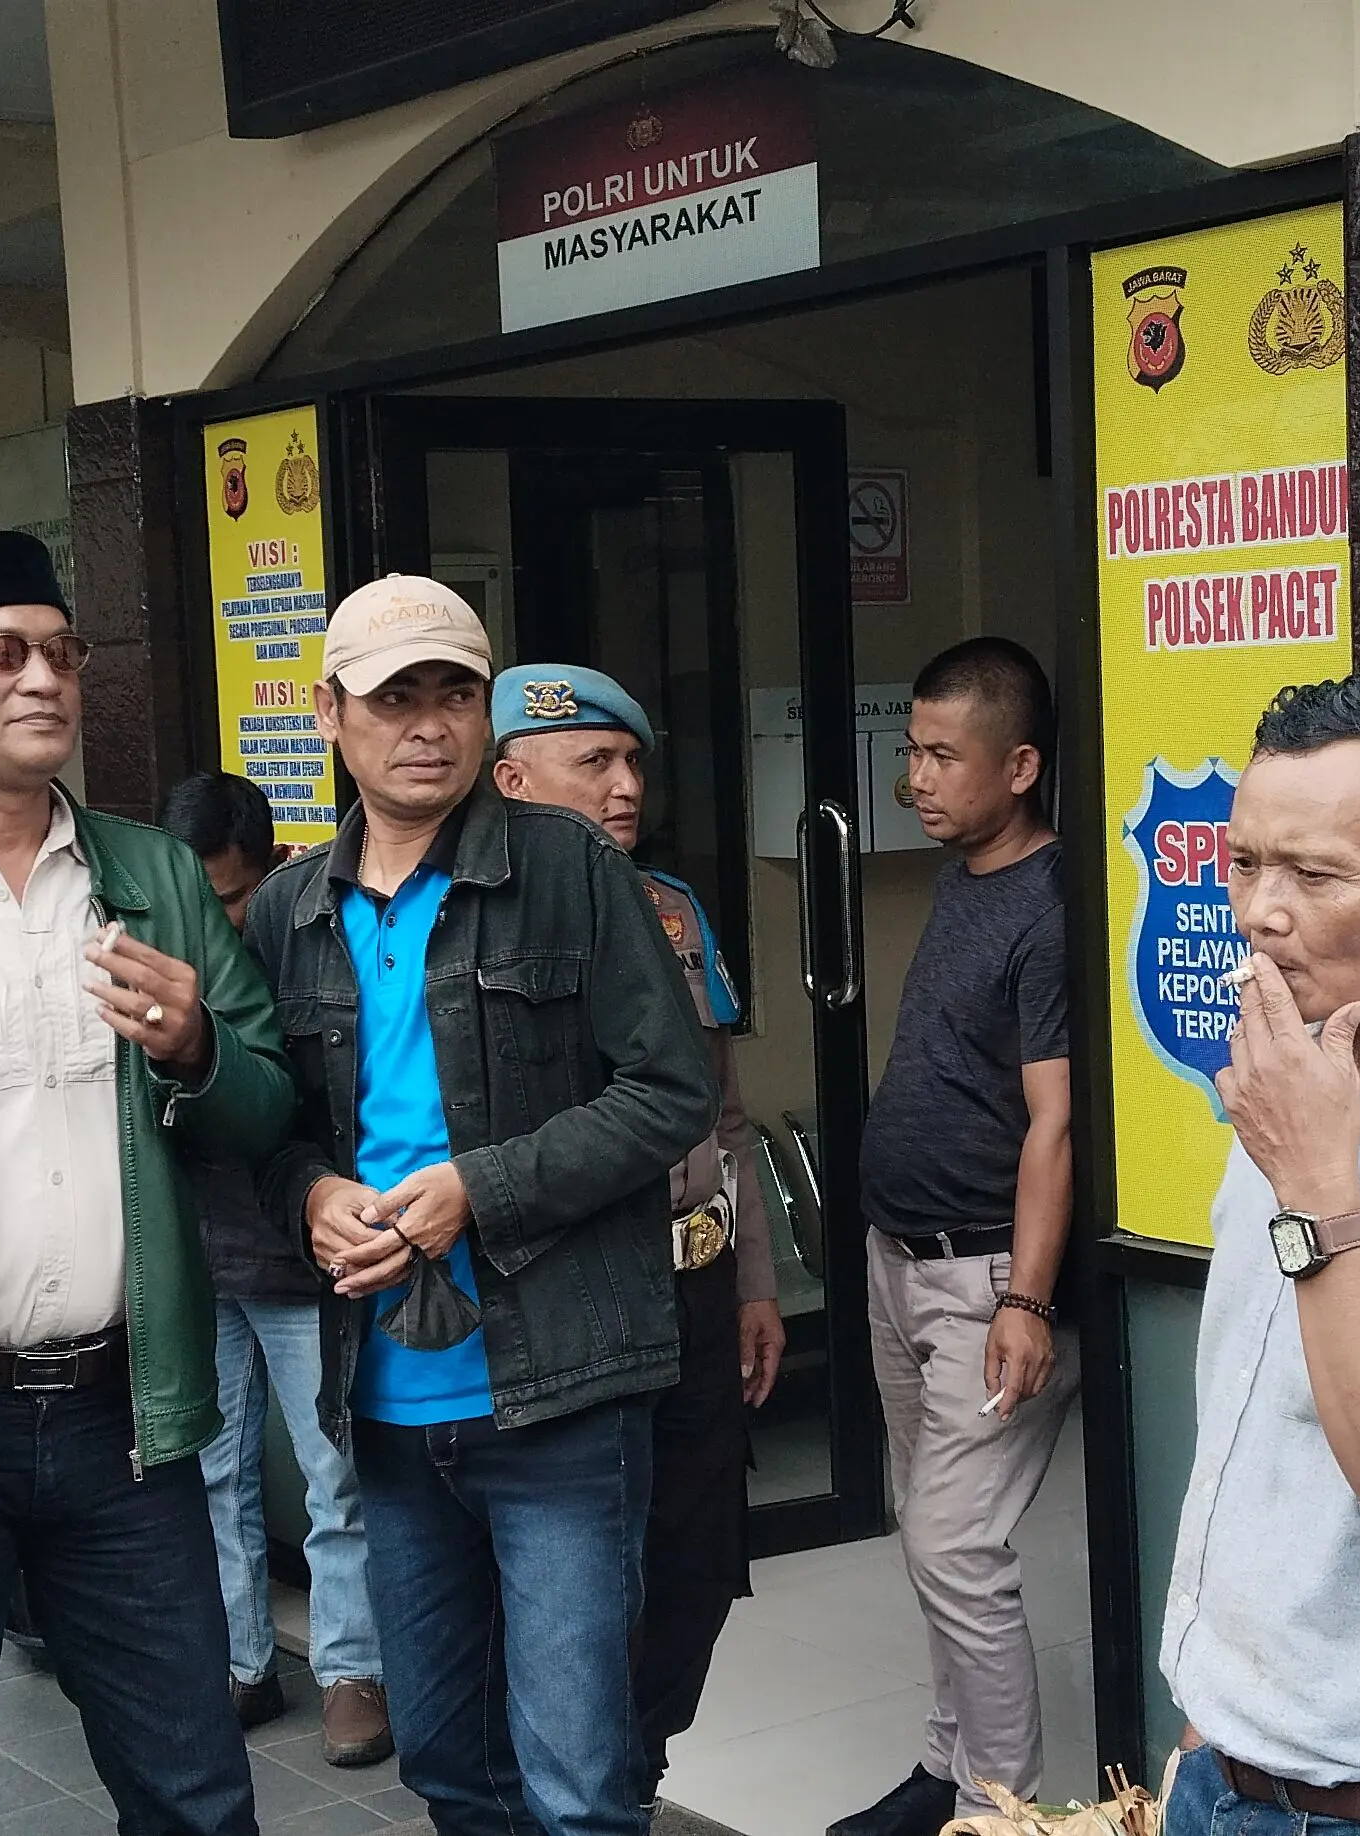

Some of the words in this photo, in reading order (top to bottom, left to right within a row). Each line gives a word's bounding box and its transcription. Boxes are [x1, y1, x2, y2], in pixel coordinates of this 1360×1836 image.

[544, 171, 633, 222] POLRI
[644, 137, 759, 196] UNTUK
[544, 188, 761, 270] MASYARAKAT
[1127, 274, 1152, 293] JAWA
[1152, 271, 1183, 284] BARAT
[1108, 479, 1236, 555] POLRESTA
[248, 541, 285, 567] VISI
[368, 603, 453, 635] ACADIA
[1148, 576, 1245, 646] POLSEK
[1251, 569, 1337, 640] PACET
[255, 682, 294, 706] MISI
